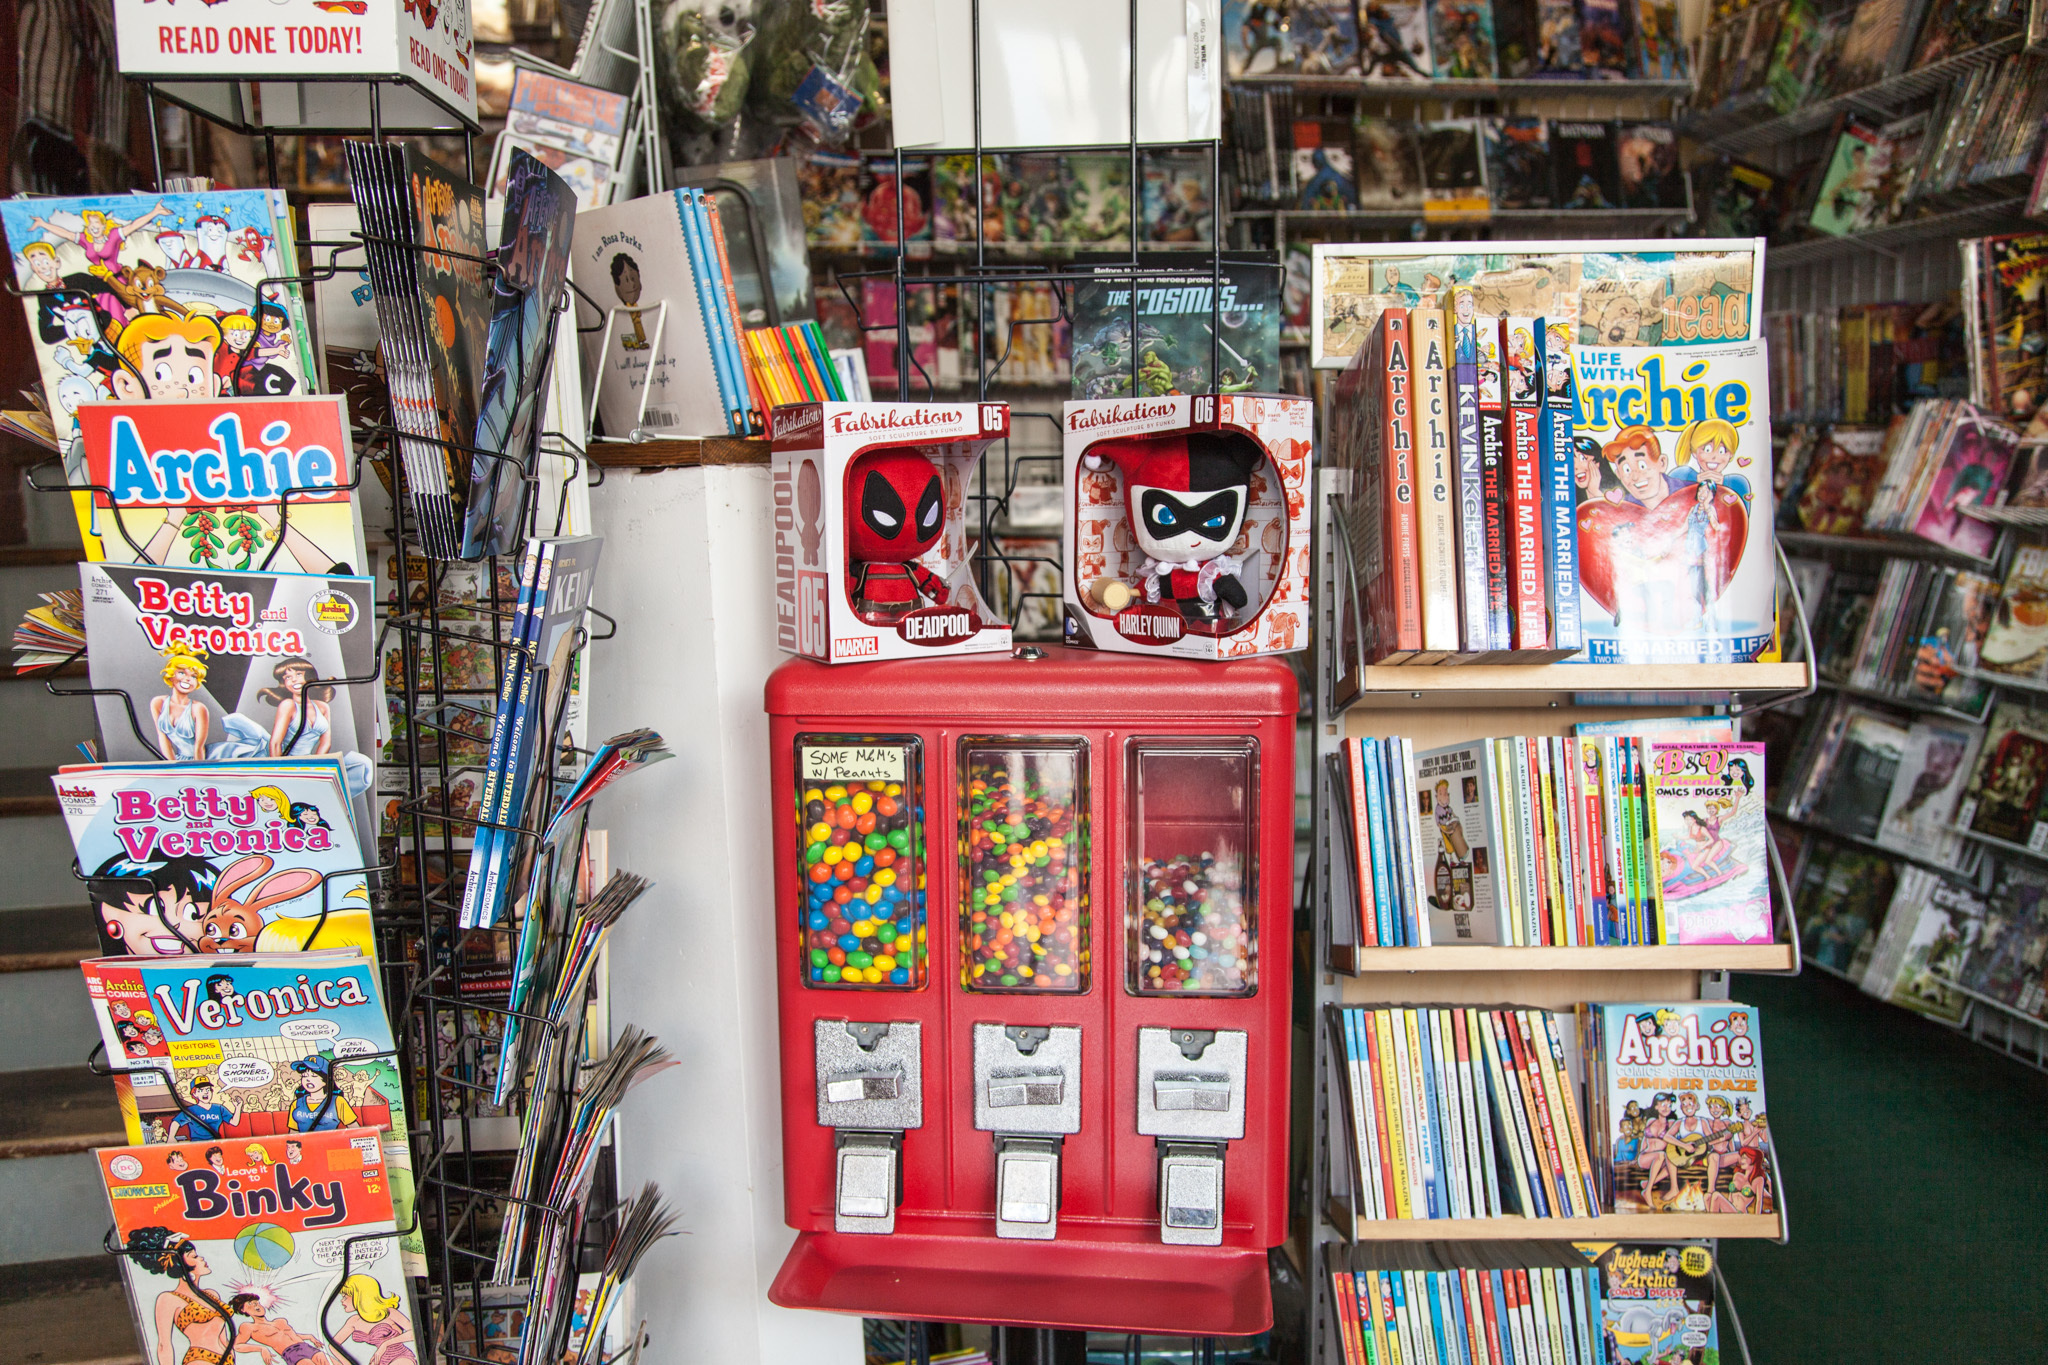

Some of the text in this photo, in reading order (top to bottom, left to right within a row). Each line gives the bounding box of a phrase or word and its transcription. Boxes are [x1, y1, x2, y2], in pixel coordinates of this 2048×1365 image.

[159, 26, 363, 54] READ ONE TODAY!
[410, 36, 431, 74] READ
[432, 55, 448, 86] ONE
[448, 62, 470, 102] TODAY!
[601, 232, 619, 248] Rosa
[1107, 290, 1131, 306] THE
[1580, 351, 1634, 381] LIFE WITH
[772, 407, 823, 440] Fabrikations
[829, 405, 1003, 434] Fabrikations 05
[1067, 397, 1214, 431] Fabrikations 06
[1387, 339, 1411, 504] Archie
[1424, 340, 1447, 504] Archie
[869, 434, 886, 442] SOFT
[889, 431, 928, 440] SCULPTURE
[1113, 426, 1145, 436] SCULPTURE
[1458, 382, 1478, 472] KEVIN
[110, 412, 338, 504] Archie
[1400, 513, 1409, 535] ARCHIE
[1482, 415, 1502, 610] Archie THE MARRIED LIFE
[1515, 409, 1537, 641] Archie THE MARRIED LIFE
[1552, 411, 1573, 642] Archie THE MARRIED LIFE
[773, 460, 797, 650] DEADPOOL
[95, 588, 108, 596] 271
[134, 577, 288, 627] Betty and
[800, 575, 826, 658] 05
[905, 613, 975, 640] DEADPOOL
[1119, 613, 1180, 639] HARLEY QUINN
[137, 616, 308, 657] Veronica
[835, 636, 878, 657] MARVEL
[488, 671, 514, 769] Keller Welcome to
[507, 674, 531, 770] Keller Welcome to
[810, 748, 897, 765] SOME M&M's
[1422, 750, 1471, 768] WHEN DO YOU LIKE YOUR
[812, 766, 891, 779] w/ Peanuts
[59, 784, 96, 797] Archie
[1695, 787, 1734, 797] DIGEST
[68, 807, 83, 815] 270
[112, 786, 259, 827] Betty
[185, 818, 214, 830] and
[113, 820, 335, 864] Veronica
[461, 869, 478, 921] Archie COMICS
[481, 870, 498, 920] Archie COMICS
[1529, 900, 1537, 938] MAGAZINE
[106, 979, 144, 992] Archie
[106, 990, 147, 999] COMICS
[154, 974, 370, 1037] Veronica
[290, 1029, 335, 1037] SHOWERS!
[1616, 1013, 1754, 1067] Archie
[172, 1042, 216, 1050] VISITORS
[174, 1053, 222, 1062] RIVERDALE
[227, 1075, 269, 1083] VERONICA!
[1616, 1066, 1757, 1079] COMICS SPECTACULAR
[1617, 1077, 1758, 1092] SUMMER DAZE
[226, 1164, 268, 1178] Leave it
[1551, 1149, 1560, 1169] DIGEST
[248, 1173, 261, 1182] to
[113, 1185, 168, 1198] SHOWCASE
[176, 1163, 347, 1228] Binky
[354, 1246, 384, 1254] INSTEAD
[355, 1252, 383, 1260] BELLE!
[1608, 1247, 1667, 1275] Jughead
[1621, 1270, 1677, 1288] Archie
[1608, 1288, 1685, 1298] COMICS DIGEST
